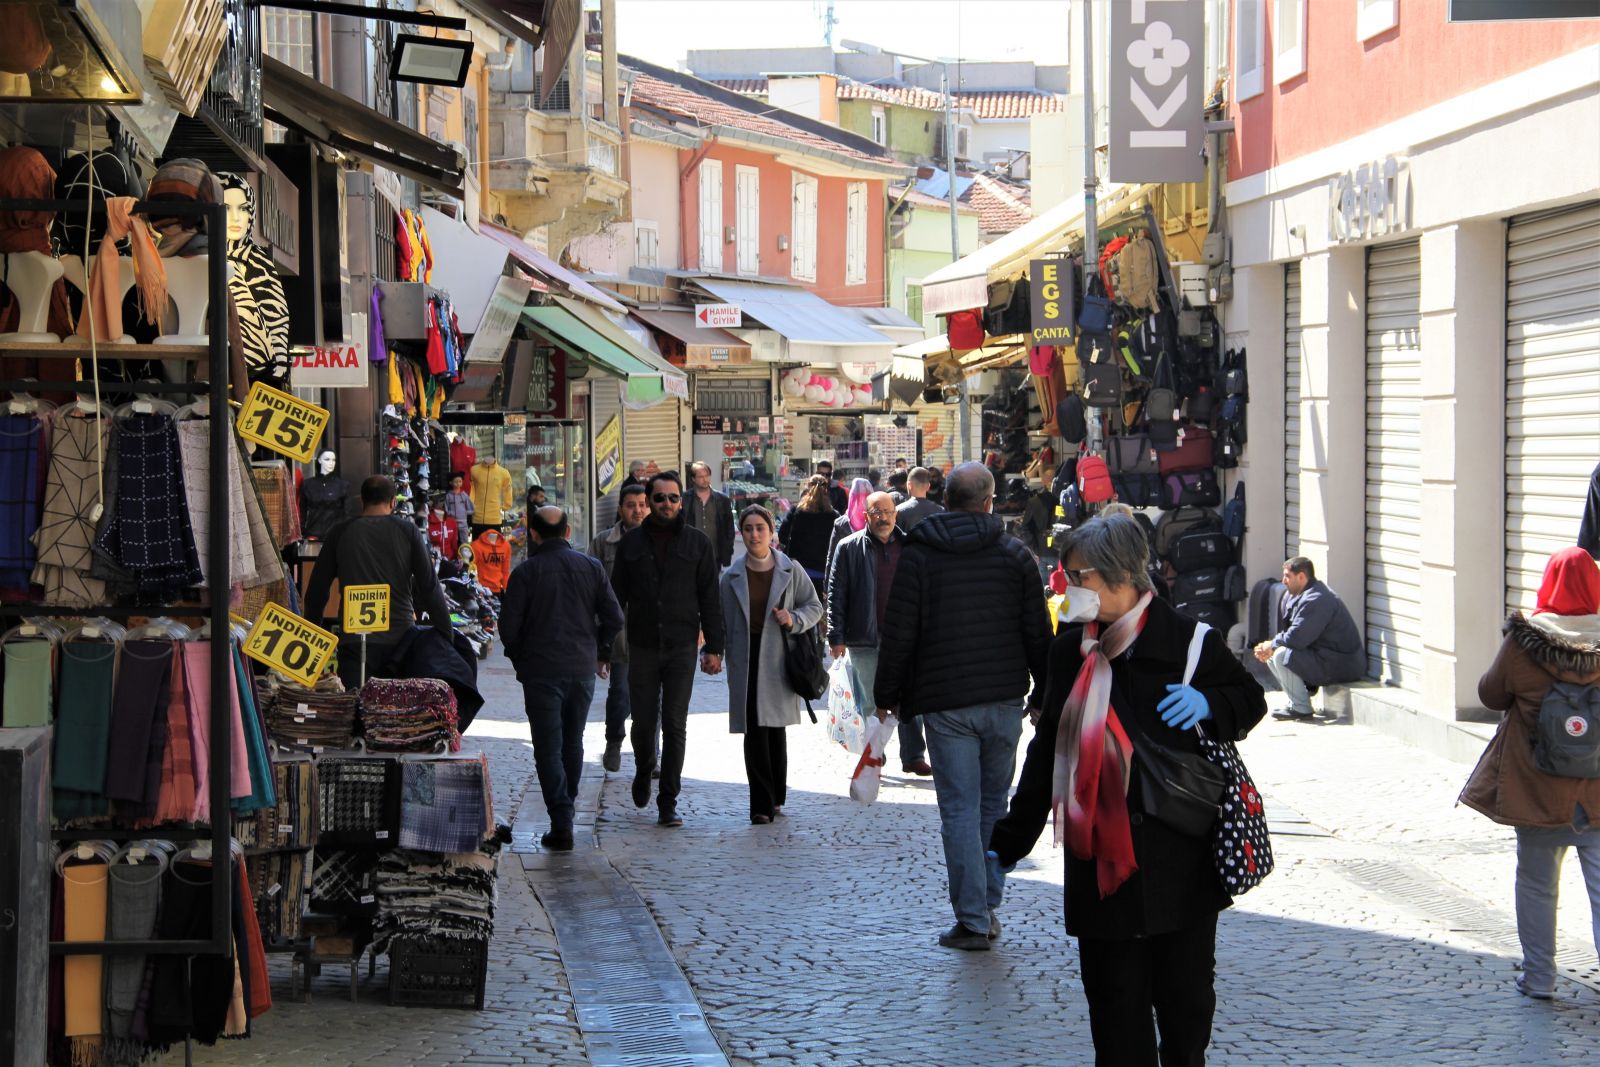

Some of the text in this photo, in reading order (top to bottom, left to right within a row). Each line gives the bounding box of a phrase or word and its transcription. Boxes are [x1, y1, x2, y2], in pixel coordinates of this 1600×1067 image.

[1042, 264, 1060, 319] EGS
[710, 306, 739, 315] HAMİLE
[713, 316, 736, 325] GİYİM
[1033, 327, 1071, 342] ÇANTA
[255, 390, 323, 427] İNDİRİM
[349, 590, 387, 602] İNDİRİM
[359, 602, 377, 626] 5
[266, 610, 330, 652] İNDİRİM
